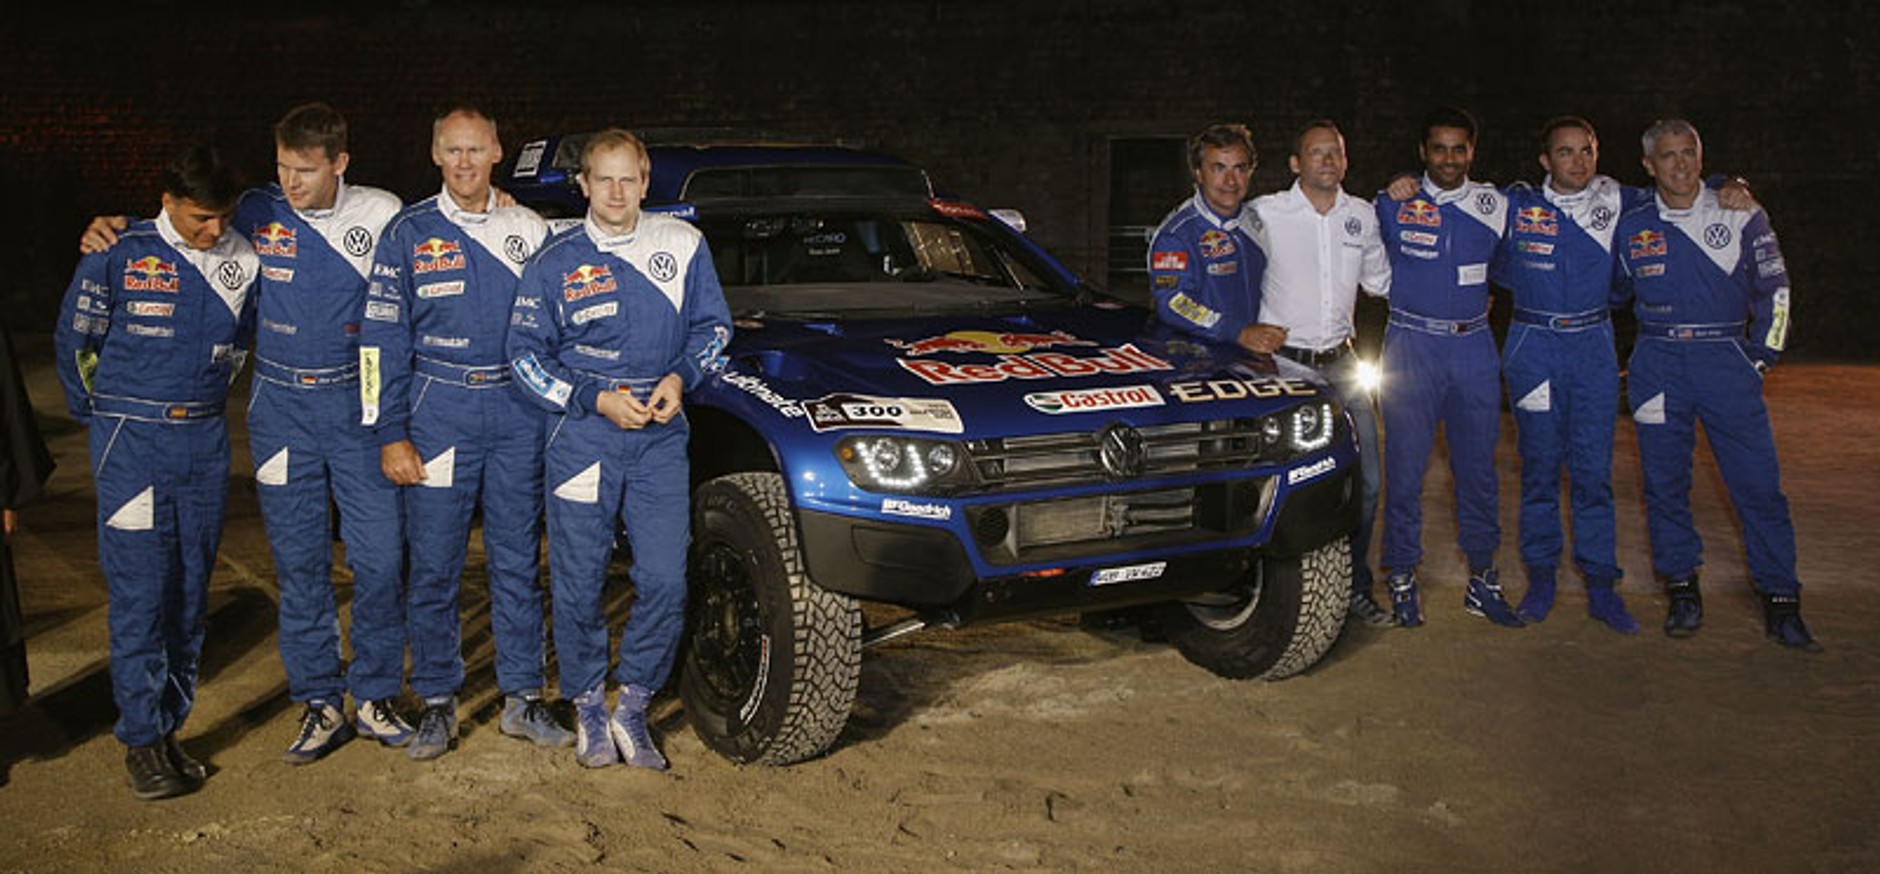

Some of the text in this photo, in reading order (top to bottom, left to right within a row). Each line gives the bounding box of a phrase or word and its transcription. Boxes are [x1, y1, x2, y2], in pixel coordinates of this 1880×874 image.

[1061, 387, 1152, 408] Castrol
[1169, 377, 1318, 403] EDGE
[852, 405, 902, 418] 300
[881, 498, 952, 521] BFGoodrich
